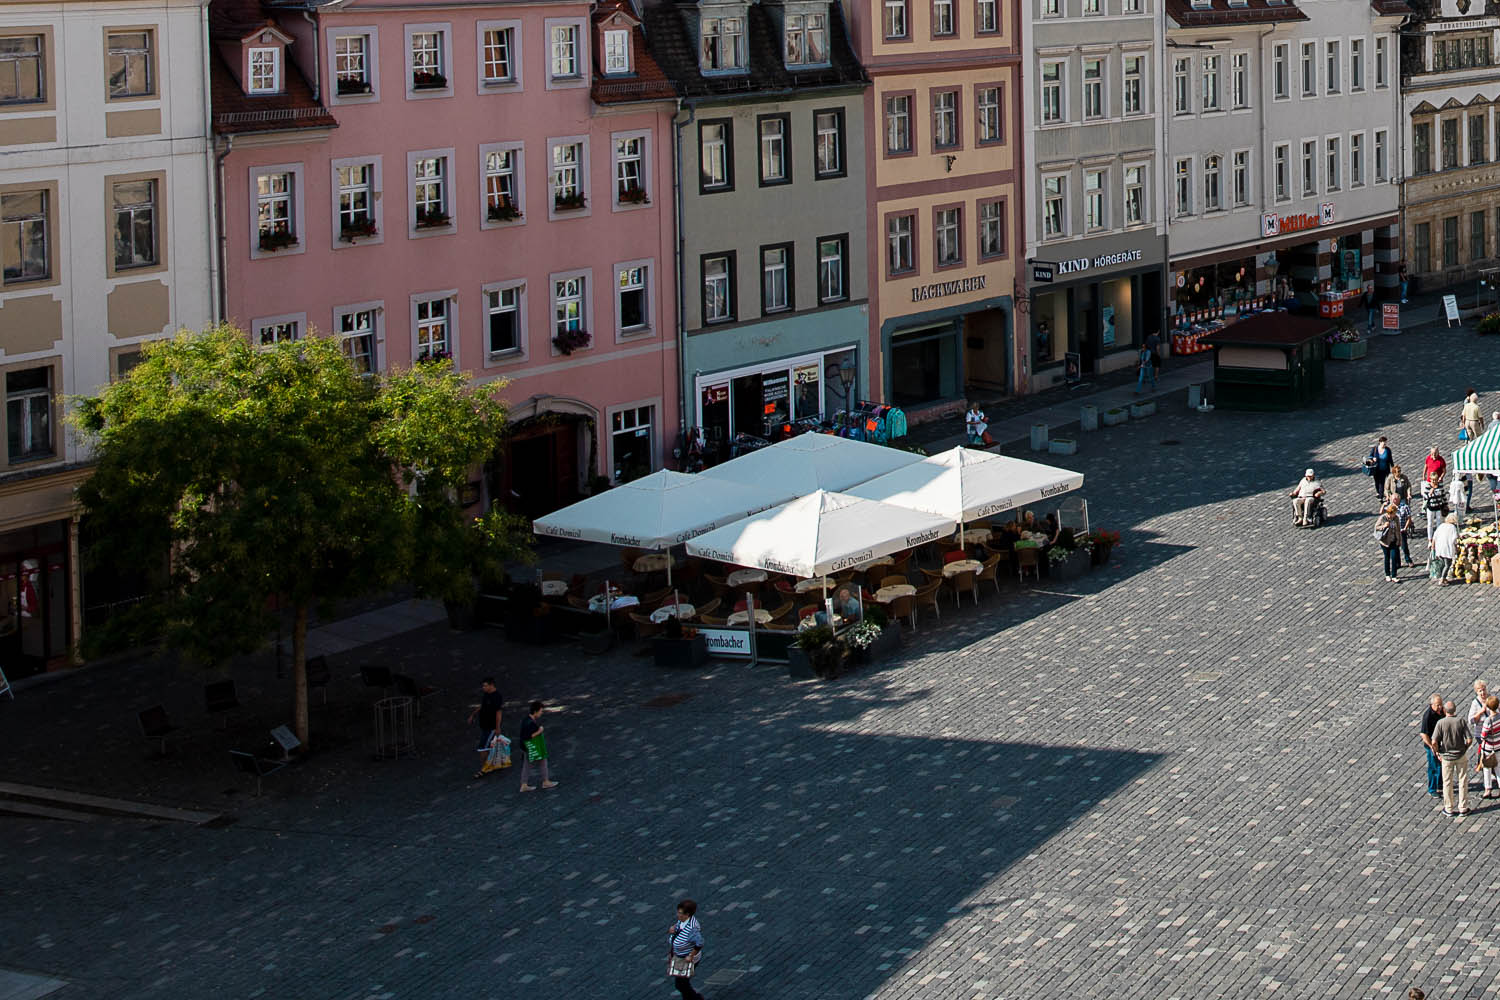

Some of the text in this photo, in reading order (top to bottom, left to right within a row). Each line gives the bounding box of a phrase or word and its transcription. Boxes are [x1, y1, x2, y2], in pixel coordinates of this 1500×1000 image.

[1279, 213, 1321, 234] Müller
[1058, 249, 1142, 275] KIND HÖRGERÄTE
[1035, 270, 1051, 279] KIND
[912, 275, 986, 302] BACKWAREN
[1040, 483, 1070, 498] Krombacher
[611, 533, 641, 546] Krombacher
[906, 530, 940, 547] Krombacher
[831, 550, 874, 571] Café Domizil
